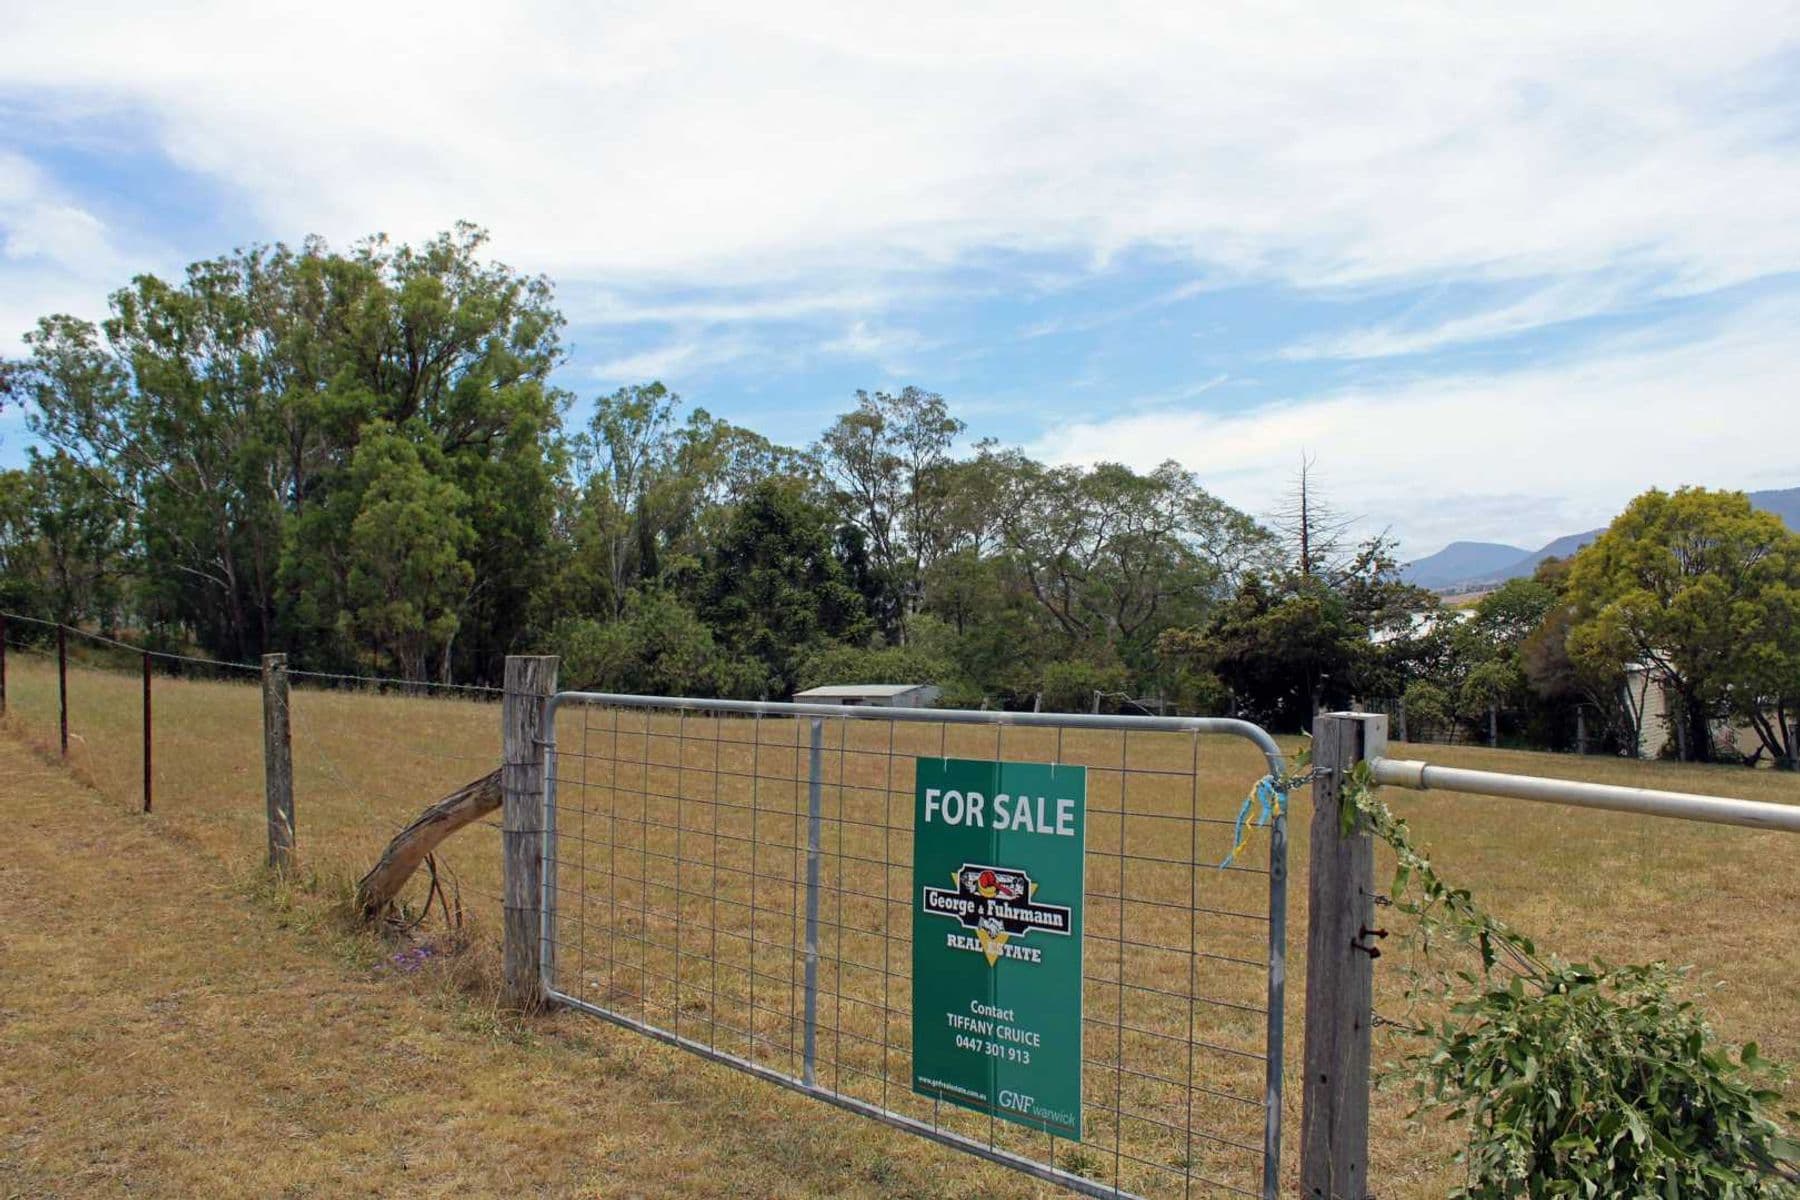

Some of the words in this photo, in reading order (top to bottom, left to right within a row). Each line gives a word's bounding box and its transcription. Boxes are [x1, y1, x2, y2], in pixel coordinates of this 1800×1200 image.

[924, 788, 984, 828] FOR
[992, 793, 1075, 836] SALE
[928, 891, 975, 916] George
[977, 904, 984, 914] &
[987, 901, 1064, 927] Fuhrmann
[947, 933, 983, 953] REAL
[970, 999, 1015, 1022] Contact
[947, 1012, 994, 1036] TIFFANY
[996, 1025, 1040, 1047] CRUICE
[956, 1034, 983, 1053] 0447
[985, 1043, 1005, 1058] 301
[1008, 1048, 1030, 1065] 913
[998, 1089, 1035, 1113] GNF
[1032, 1105, 1075, 1127] warwick
